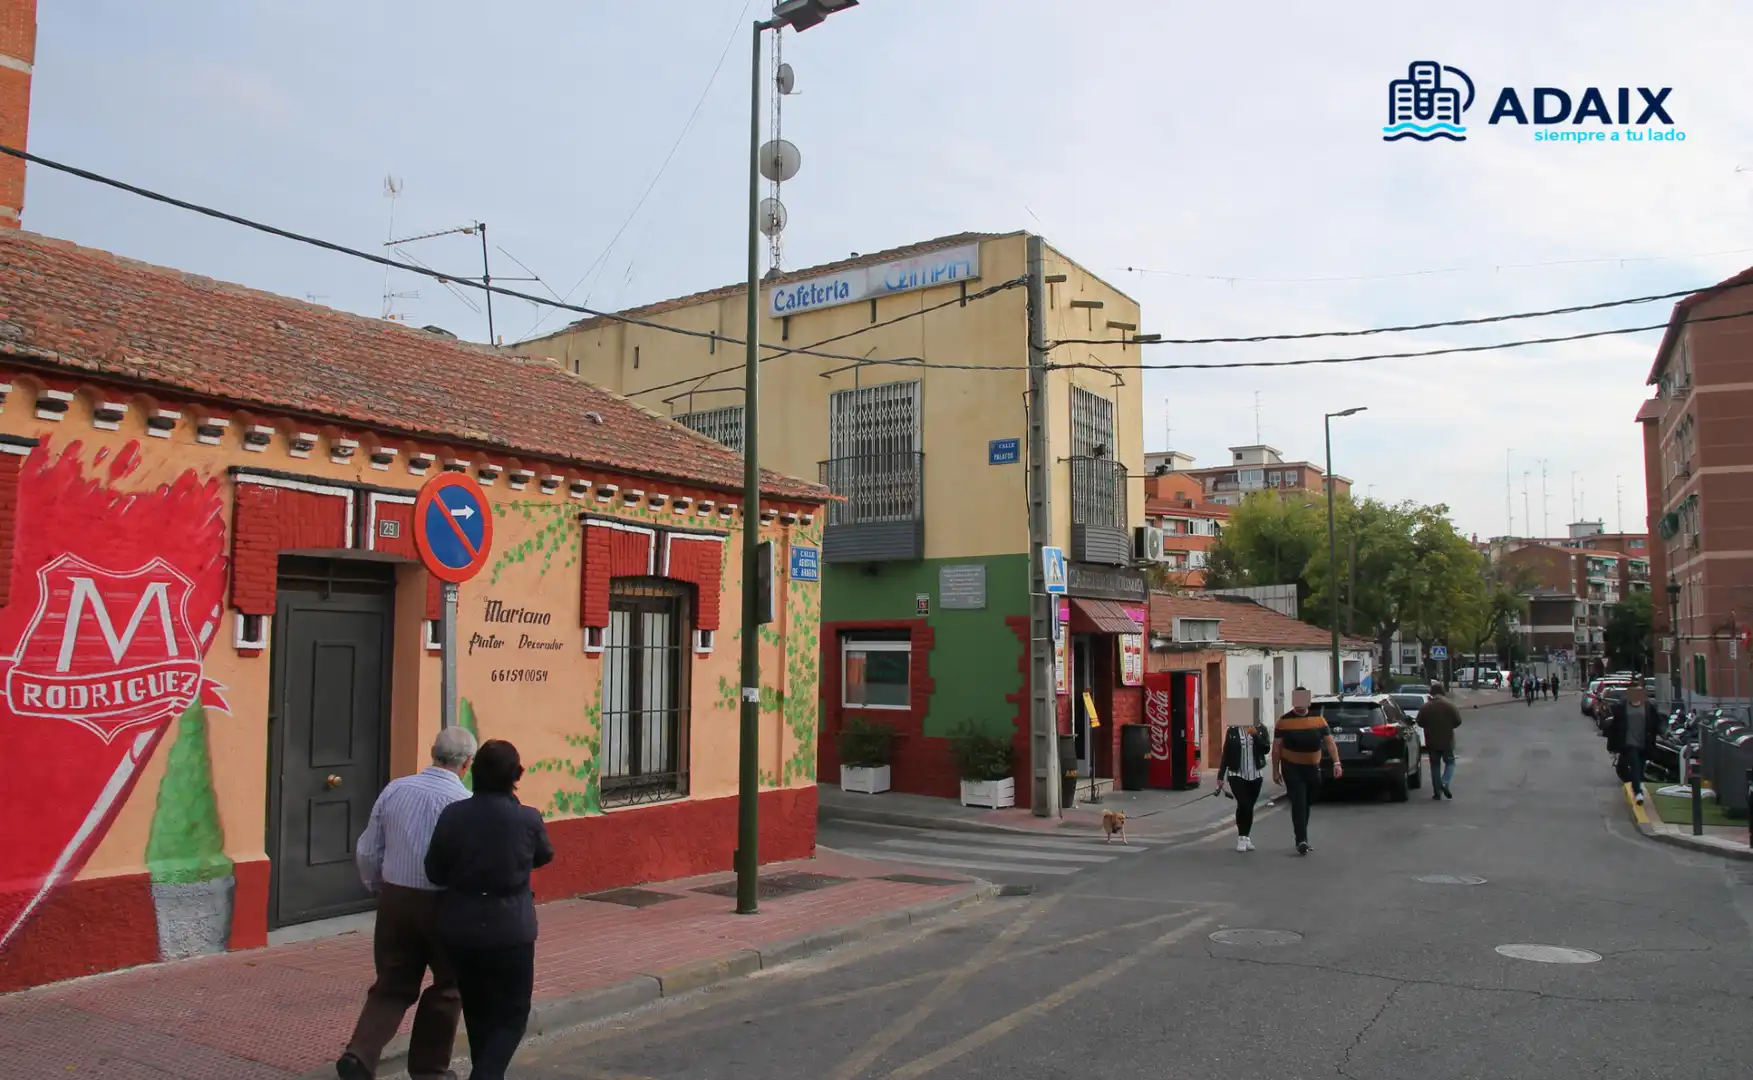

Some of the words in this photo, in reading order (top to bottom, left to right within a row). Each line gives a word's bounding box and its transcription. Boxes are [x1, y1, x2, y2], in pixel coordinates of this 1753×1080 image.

[773, 279, 850, 312] Cafeteria
[383, 522, 395, 536] 29
[792, 567, 799, 577] DE
[56, 576, 178, 673] M
[484, 600, 552, 625] Mariano
[468, 631, 505, 656] Pintor
[518, 633, 564, 650] Decorador
[22, 670, 198, 709] RODRIGUEZ
